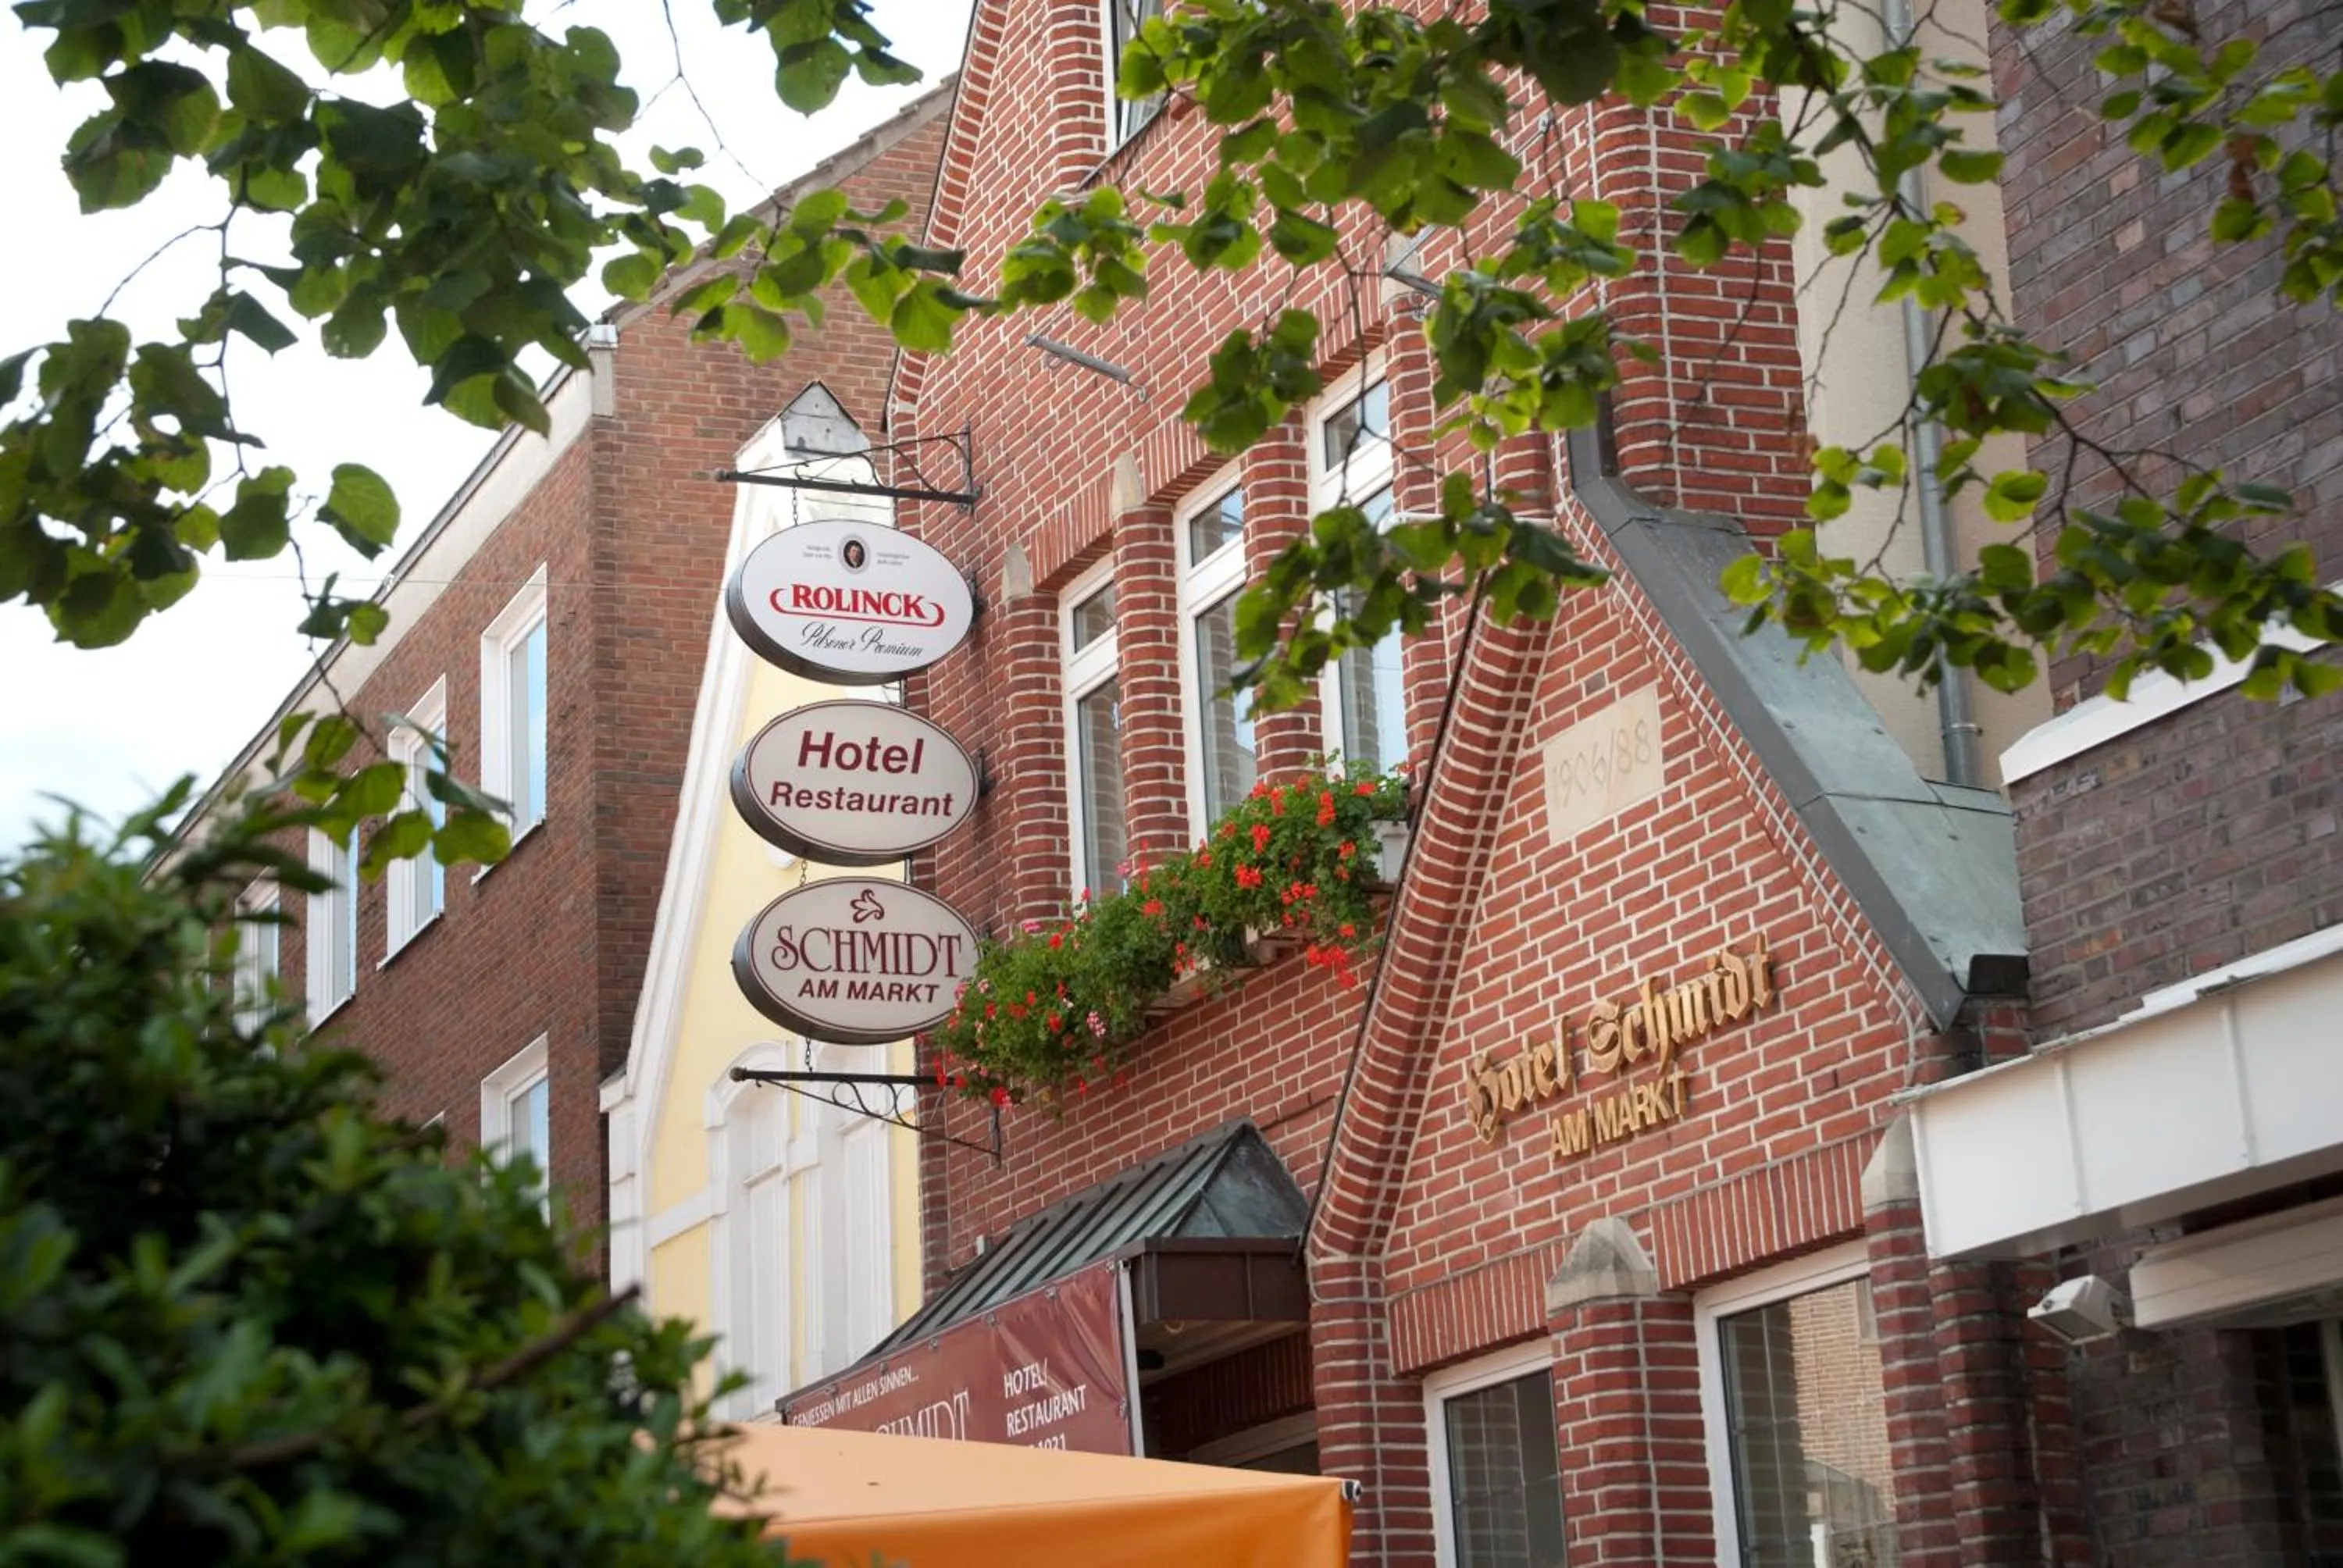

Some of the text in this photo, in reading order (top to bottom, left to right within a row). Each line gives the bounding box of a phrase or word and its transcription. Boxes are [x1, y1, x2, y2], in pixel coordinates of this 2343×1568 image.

[791, 583, 929, 619] ROLINCK
[858, 625, 925, 657] Premium
[797, 730, 925, 775] Hotel
[769, 781, 954, 817] Restaurant
[770, 924, 962, 978] SCHMIDT
[797, 978, 940, 1003] AM MARKT
[1467, 932, 1775, 1145] Hotel Schmidt
[1550, 1070, 1689, 1161] AM MARKT
[834, 1392, 851, 1413] MIT
[851, 1380, 879, 1408] ALLEN
[1007, 1383, 1086, 1438] RESTAURANT
